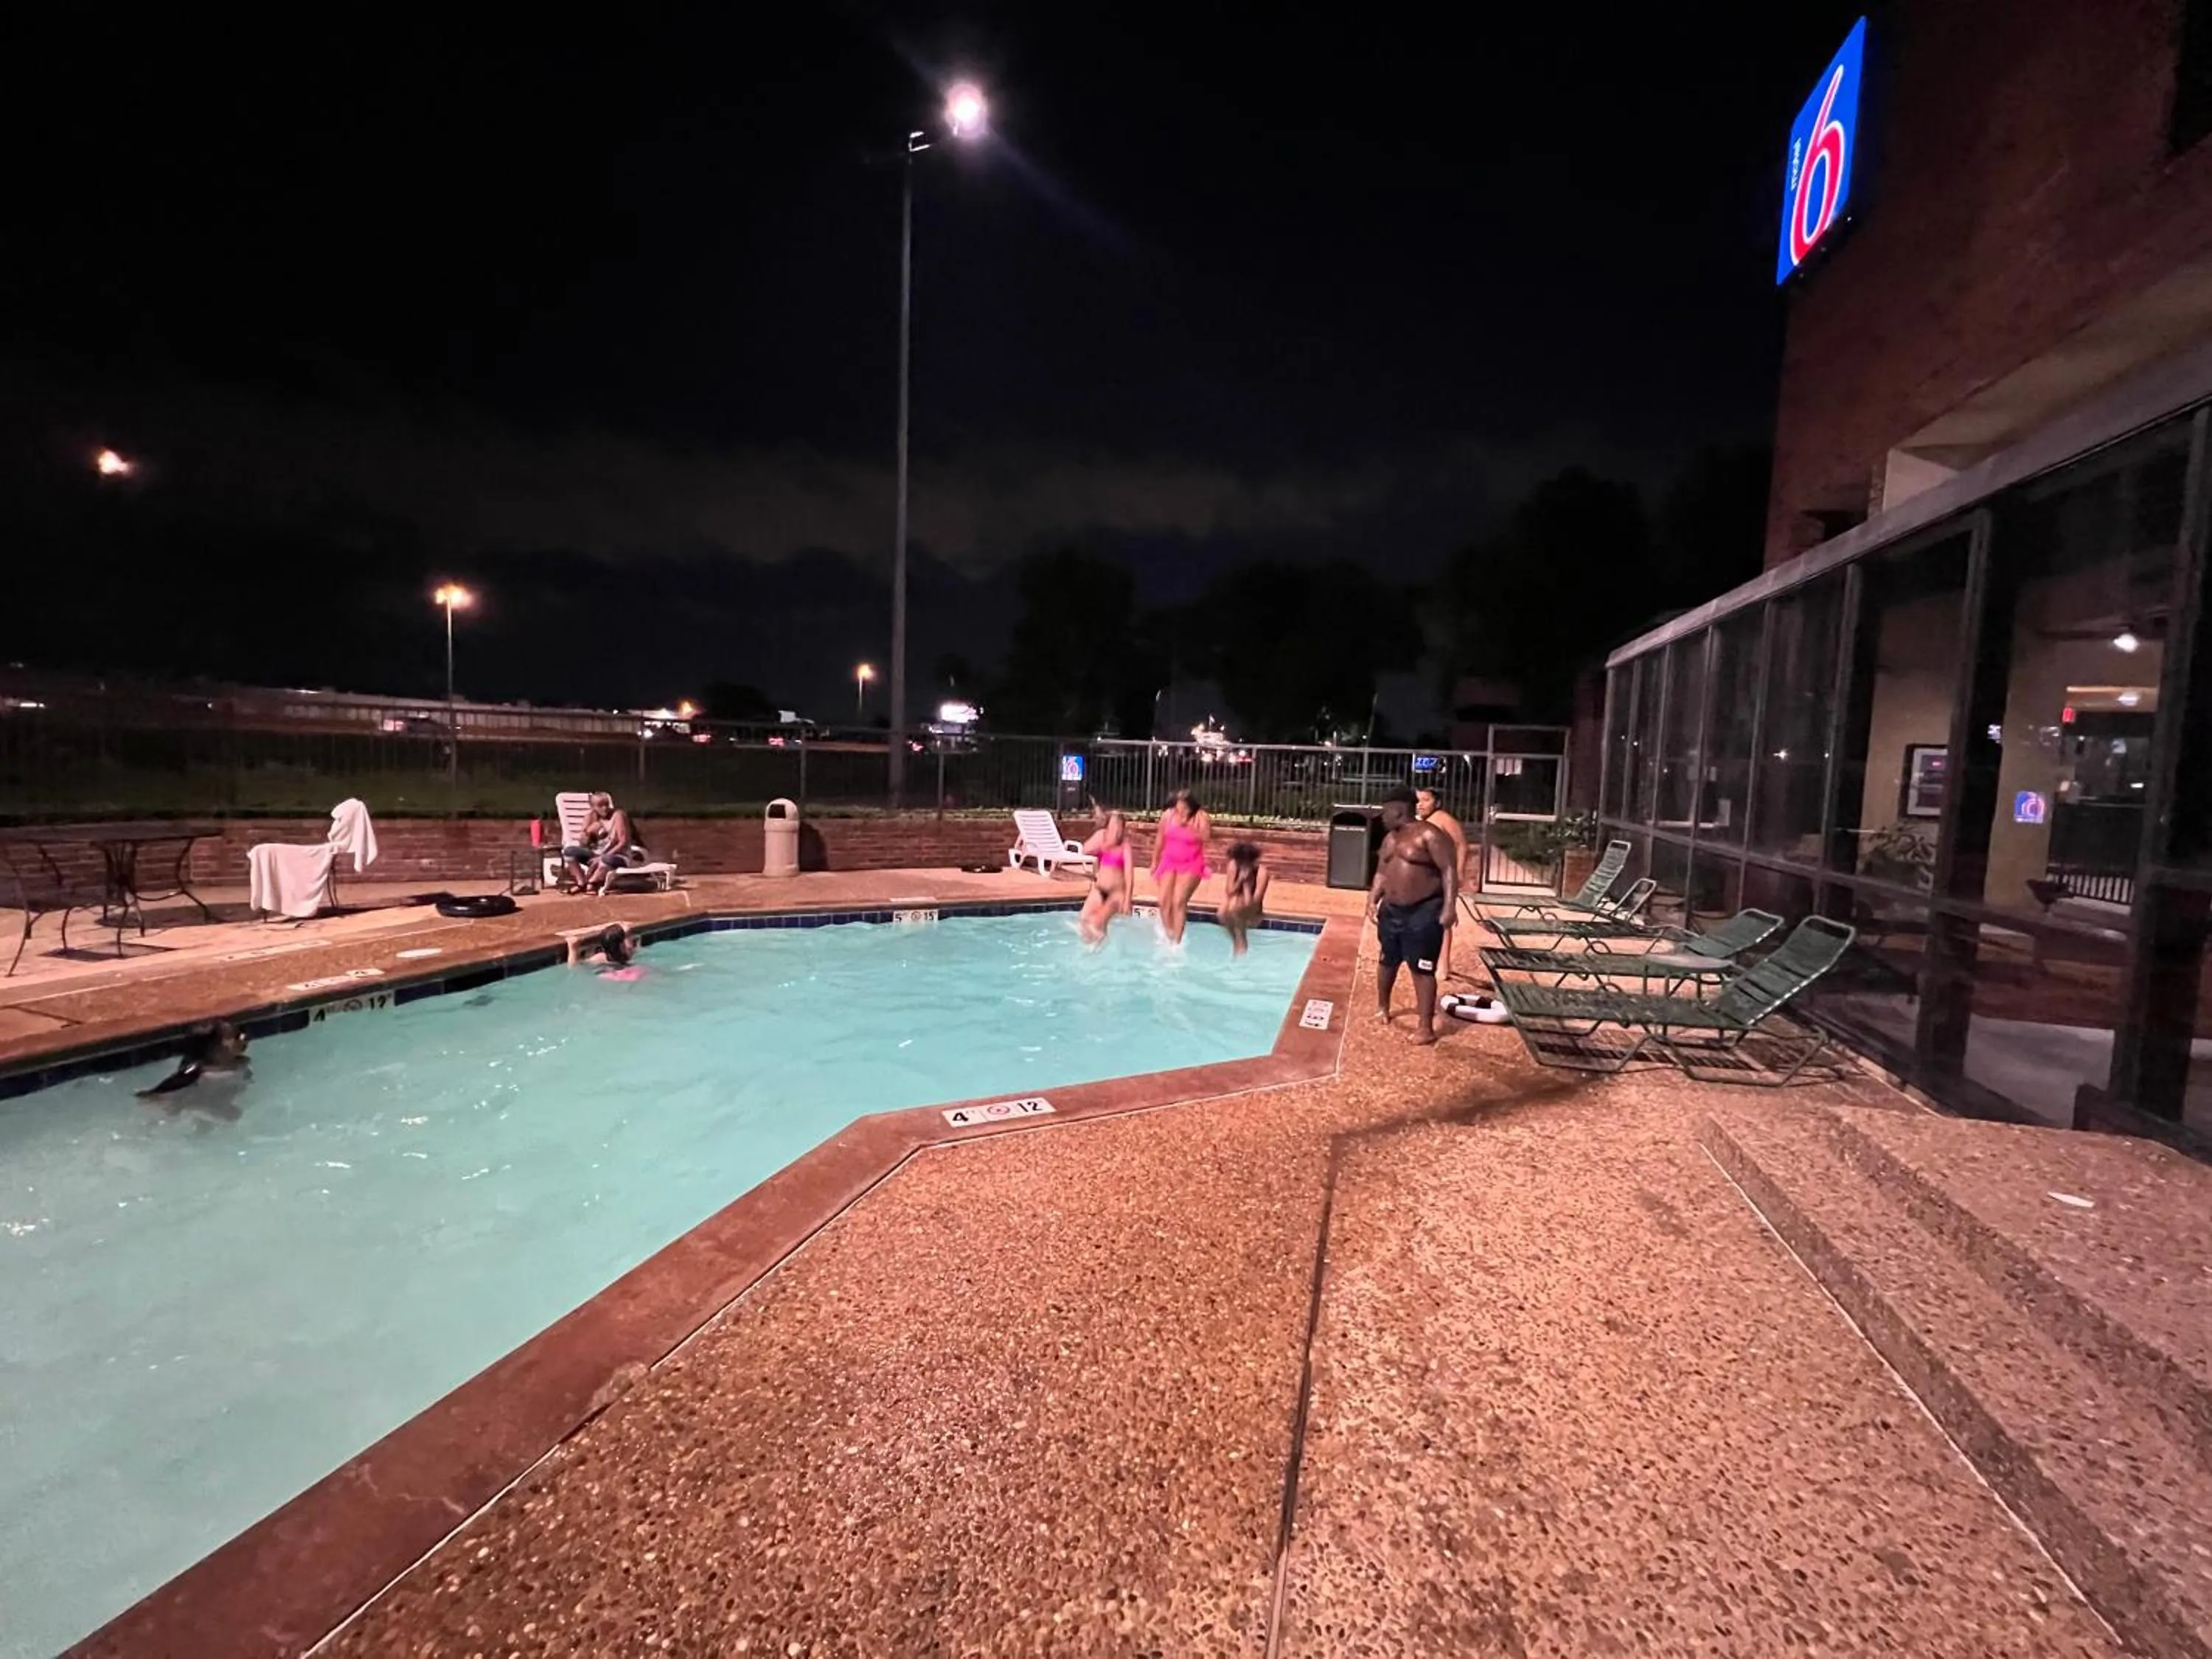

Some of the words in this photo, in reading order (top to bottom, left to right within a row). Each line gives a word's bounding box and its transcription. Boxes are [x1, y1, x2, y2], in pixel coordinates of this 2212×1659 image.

[1790, 64, 1845, 266] 6
[953, 1112, 968, 1122] 4
[1018, 1101, 1043, 1113] 12
